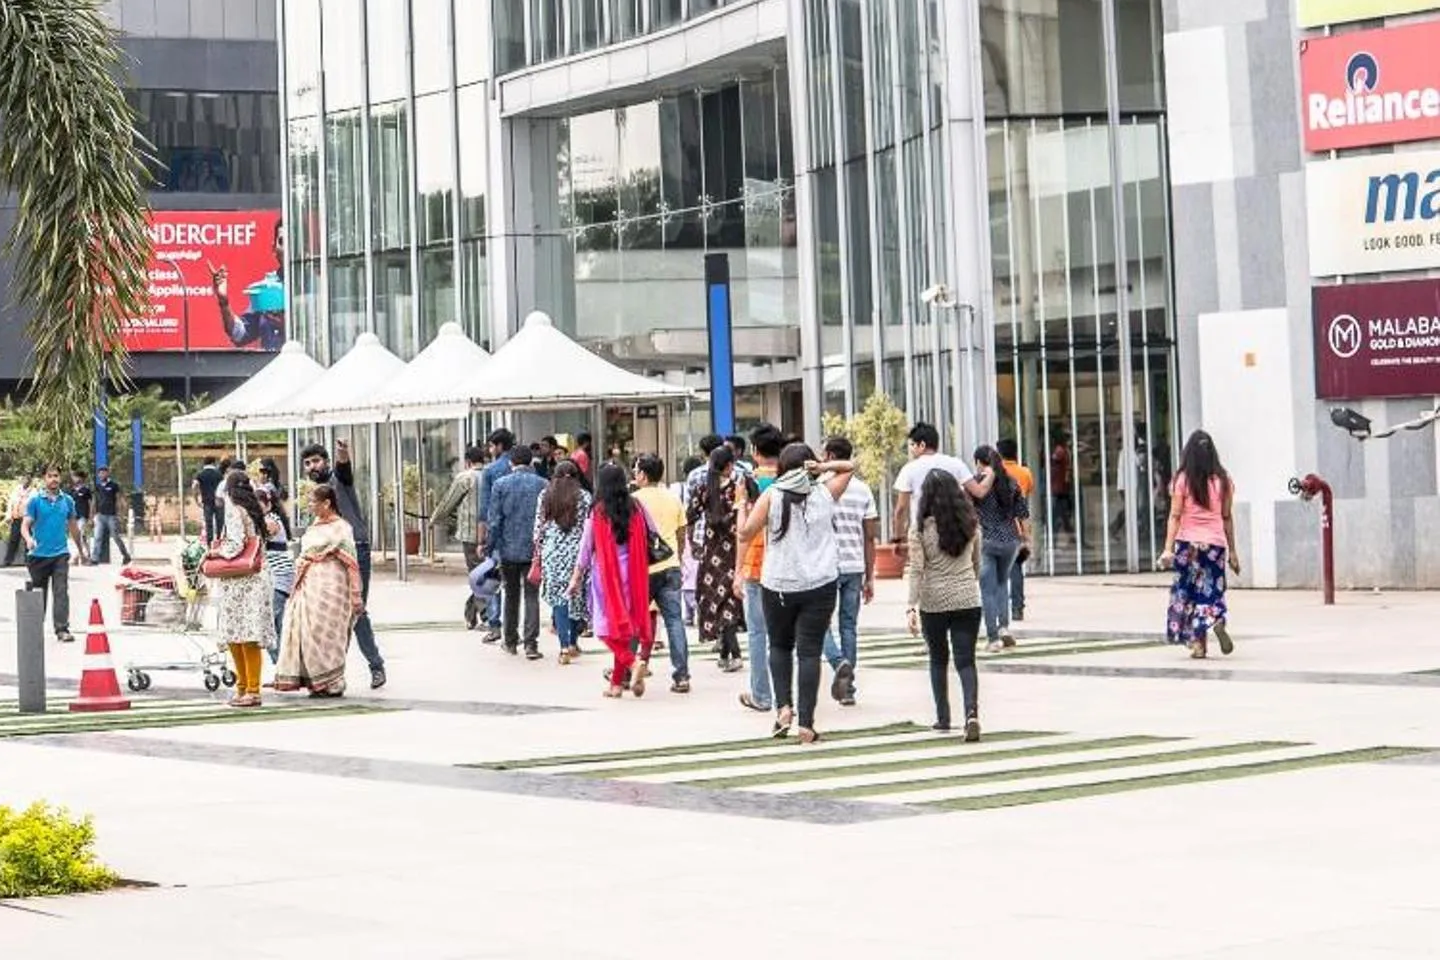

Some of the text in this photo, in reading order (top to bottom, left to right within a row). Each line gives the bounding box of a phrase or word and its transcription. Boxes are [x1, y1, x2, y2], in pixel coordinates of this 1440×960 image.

[1308, 87, 1440, 131] Reliance
[1364, 237, 1391, 251] LOOK
[1369, 338, 1397, 350] GOLD
